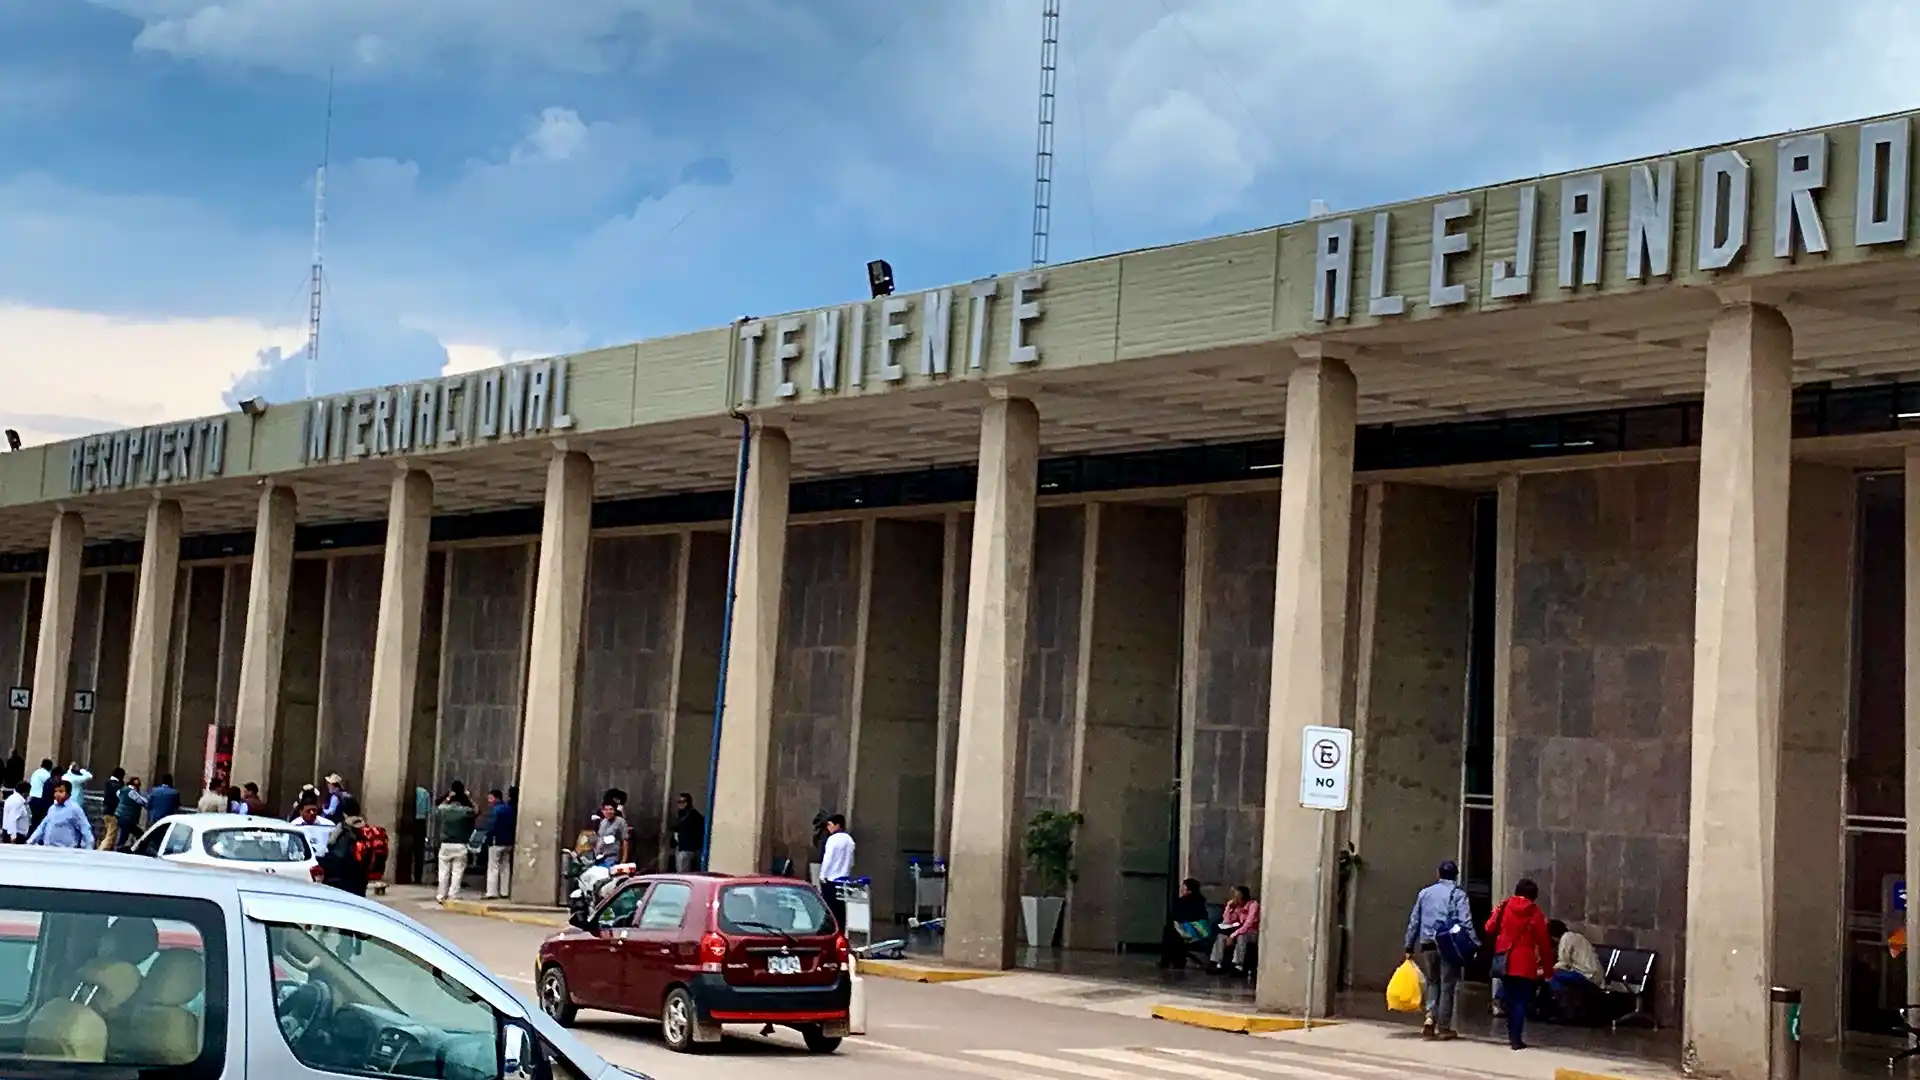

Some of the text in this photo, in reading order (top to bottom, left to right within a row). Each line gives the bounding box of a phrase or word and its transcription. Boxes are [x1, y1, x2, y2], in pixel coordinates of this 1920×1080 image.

[69, 117, 1909, 494] AEROPUERTO INTERNACIONAL TENIENTE ALEJANDRO
[1315, 777, 1335, 788] NO
